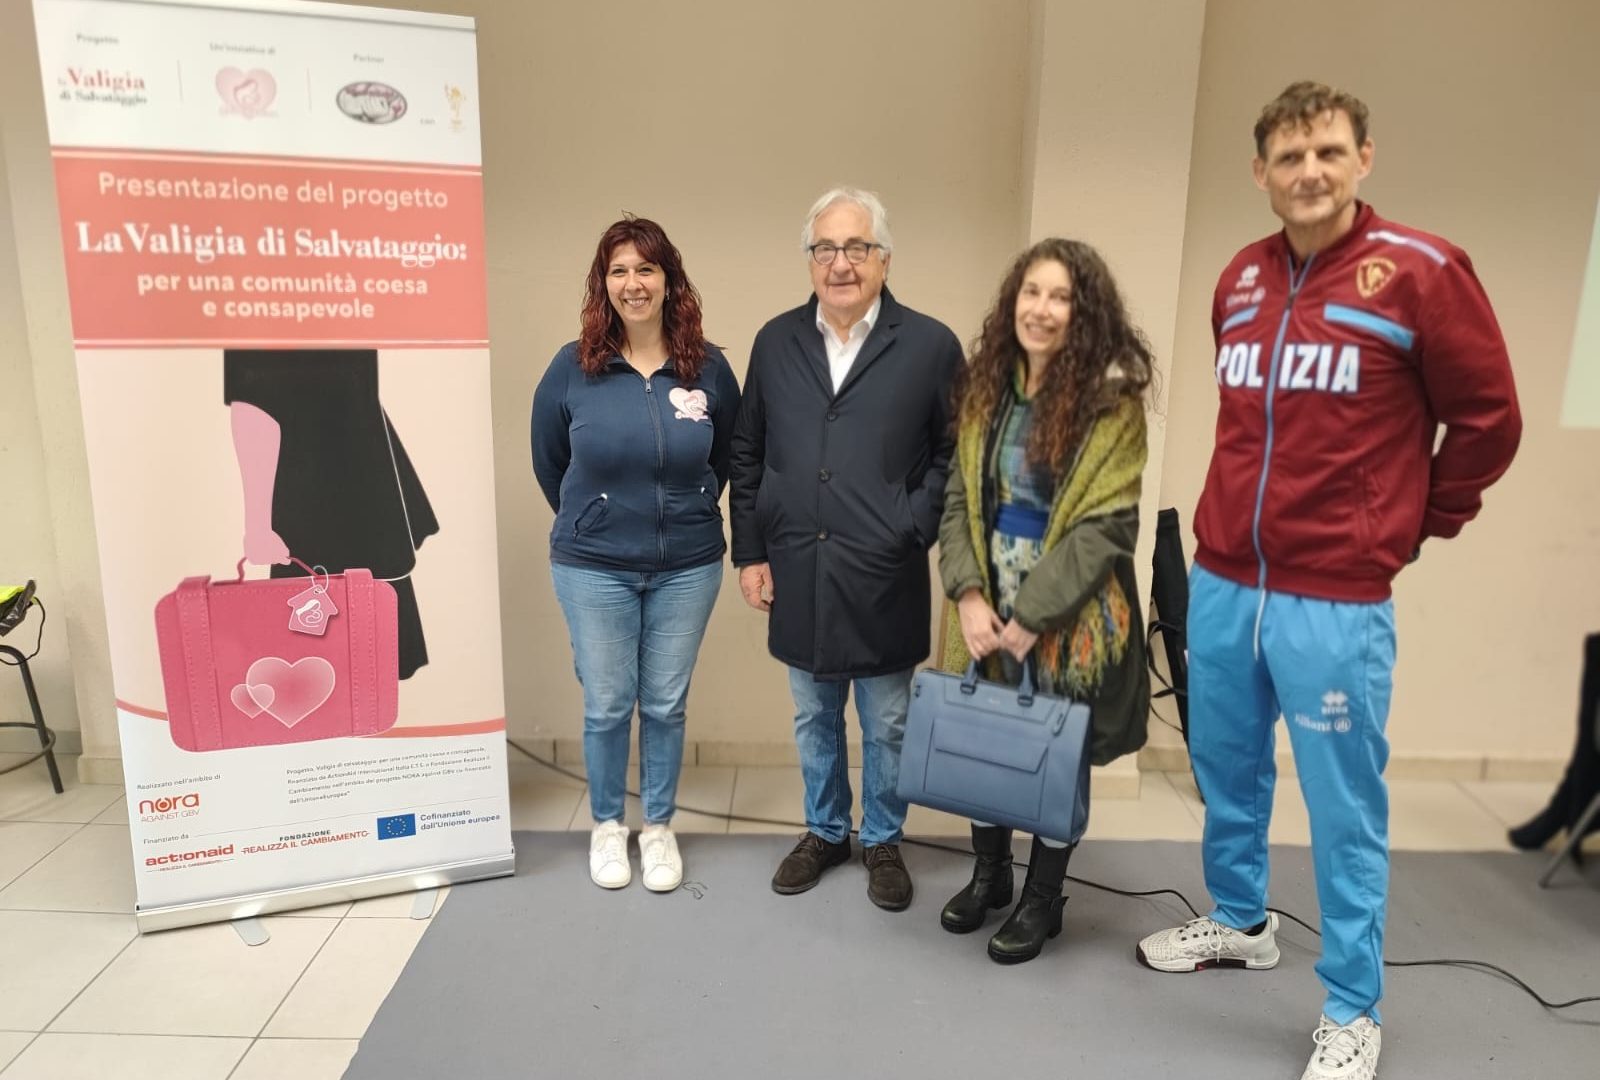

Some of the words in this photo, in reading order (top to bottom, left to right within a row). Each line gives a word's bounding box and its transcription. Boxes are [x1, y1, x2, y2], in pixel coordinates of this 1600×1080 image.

[67, 66, 146, 93] Valigia
[59, 90, 71, 101] di
[75, 90, 148, 107] Salvataggio
[99, 172, 289, 202] Presentazione
[297, 180, 334, 203] del
[342, 184, 448, 211] progetto
[76, 222, 123, 253] La
[123, 223, 246, 263] Valigia
[257, 227, 286, 256] di
[294, 228, 467, 268] Salvataggio:
[137, 273, 180, 296] per
[188, 274, 235, 292] una
[242, 271, 356, 294] comunità
[364, 278, 428, 295] coesa
[202, 301, 217, 317] e
[224, 298, 375, 322] consapevole
[1216, 343, 1361, 393] POLIZIA
[137, 781, 172, 790] Realizzato
[174, 776, 213, 786] nell'ambito
[139, 793, 200, 814] nora
[140, 812, 179, 823] AGAINST
[180, 809, 200, 818] GBV
[420, 809, 471, 822] Cofinanziato
[420, 819, 467, 831] dall'Unione
[468, 814, 501, 825] europea
[143, 835, 179, 845] Finanziato
[279, 829, 332, 842] FONDAZIONE
[300, 830, 369, 847] CAMBIAMENTO
